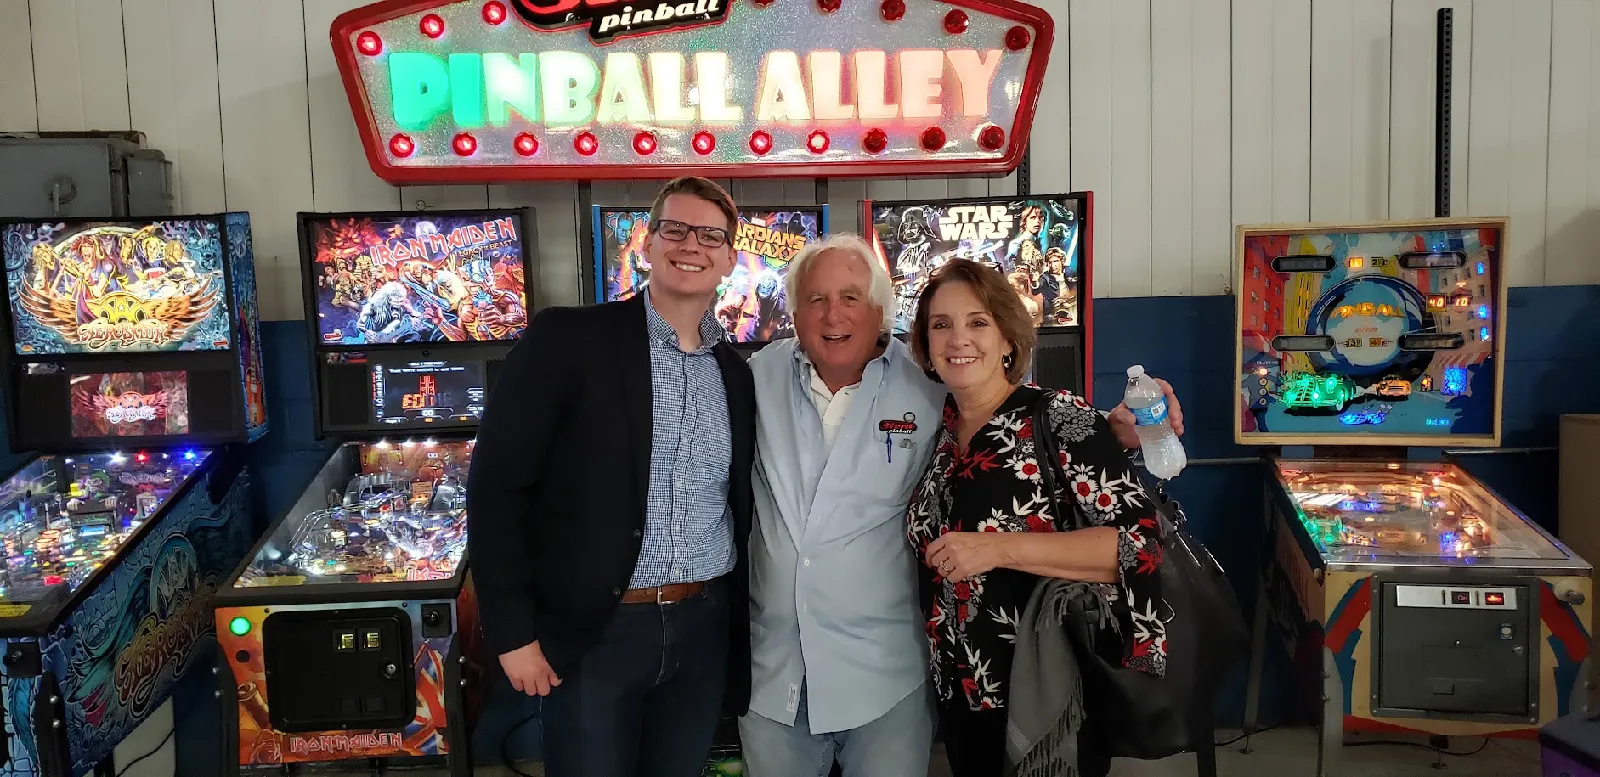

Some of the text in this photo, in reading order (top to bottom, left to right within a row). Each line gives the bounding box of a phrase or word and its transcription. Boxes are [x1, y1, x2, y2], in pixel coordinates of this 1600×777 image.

[598, 0, 720, 32] pinball
[388, 49, 1003, 127] PINBALL ALLEY
[940, 205, 1013, 222] STAR
[939, 221, 1013, 241] WARS
[370, 217, 517, 267] IRON MAIDEN
[489, 239, 513, 250] BEAST
[1456, 297, 1468, 307] 10
[289, 732, 403, 755] IRON MAIDEN
